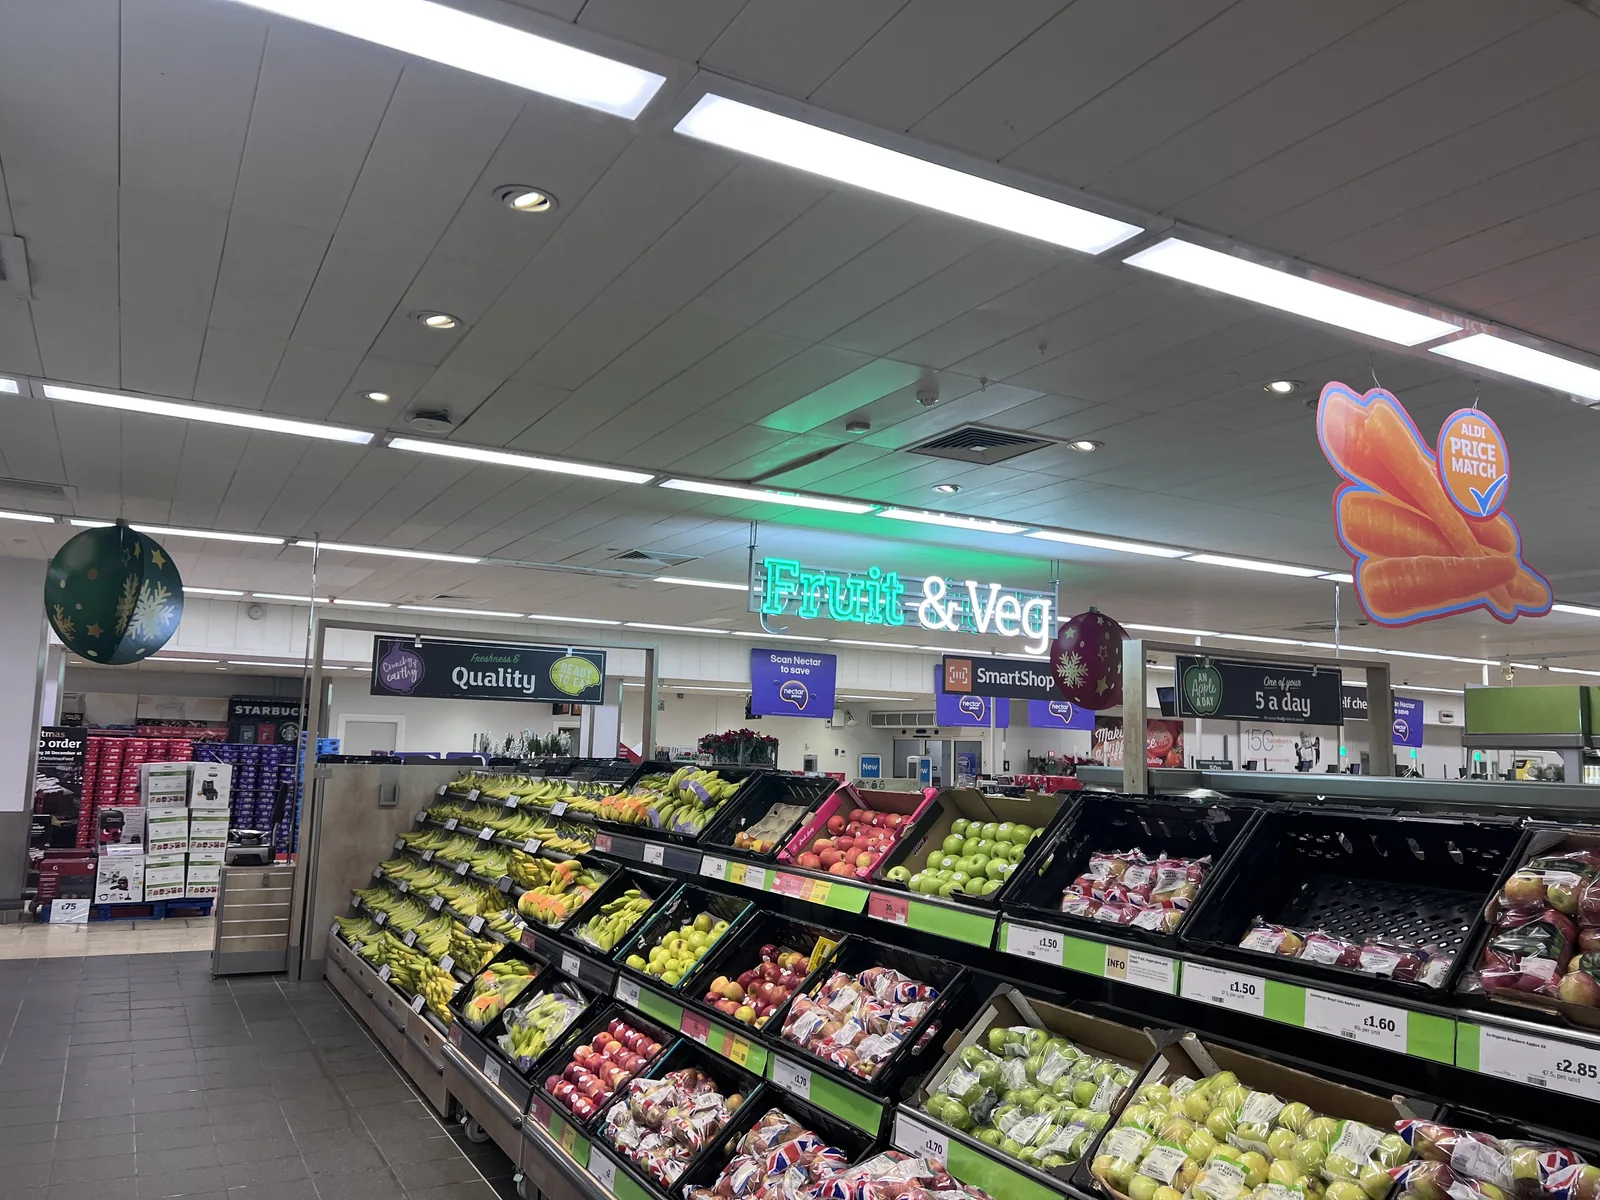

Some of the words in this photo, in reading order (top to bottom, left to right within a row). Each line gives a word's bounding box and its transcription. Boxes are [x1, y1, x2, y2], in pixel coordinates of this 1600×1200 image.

[1461, 423, 1486, 439] ALDI
[1450, 436, 1497, 462] PRICE
[1452, 457, 1497, 479] MATCH
[761, 556, 905, 626] Fruit
[918, 575, 959, 631] &
[964, 579, 1052, 655] Veg
[382, 656, 412, 672] Crunchy
[470, 653, 512, 663] Freshness
[512, 654, 520, 664] &
[770, 654, 792, 664] Scan
[794, 656, 821, 667] Nectar
[387, 666, 418, 683] earthy
[560, 662, 593, 679] READY
[780, 665, 789, 674] to
[790, 667, 810, 675] save
[1198, 672, 1208, 683] AN
[451, 666, 536, 694] Quality
[558, 674, 568, 685] TO
[977, 667, 1055, 691] SmartShop
[1263, 675, 1277, 687] One
[1277, 676, 1286, 691] of
[1286, 678, 1302, 691] your
[1191, 678, 1217, 699] Apple
[1196, 698, 1201, 707] A
[1201, 696, 1214, 706] DAY
[1255, 691, 1264, 709] 5
[1268, 696, 1279, 711] a
[1281, 692, 1311, 717] day
[48, 738, 82, 748] order
[862, 763, 878, 771] New
[61, 902, 77, 911] £75
[1039, 937, 1058, 949] £1.50
[1107, 958, 1125, 970] INFO
[1230, 981, 1256, 996] £1.50
[1363, 1015, 1395, 1032] £1.60
[1556, 1059, 1598, 1079] £2.85
[794, 1074, 807, 1087] £1.70
[1568, 1076, 1581, 1084] unit
[925, 1139, 943, 1155] £1.70
